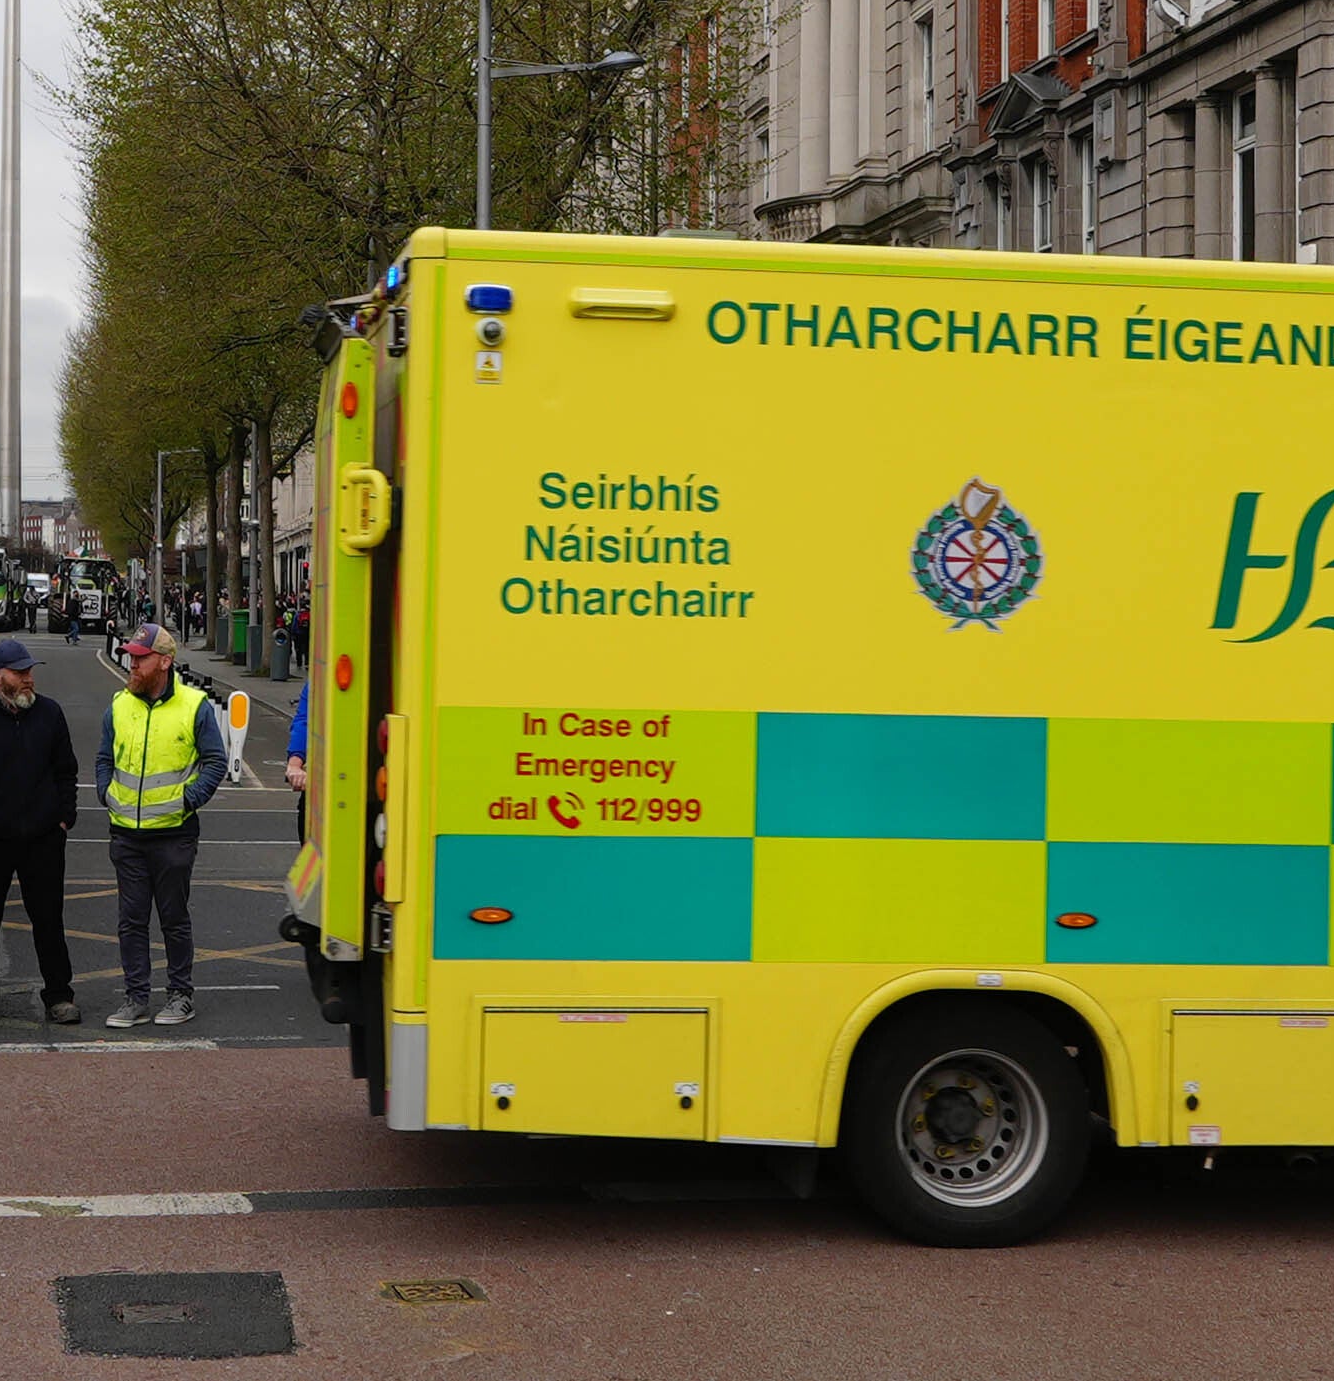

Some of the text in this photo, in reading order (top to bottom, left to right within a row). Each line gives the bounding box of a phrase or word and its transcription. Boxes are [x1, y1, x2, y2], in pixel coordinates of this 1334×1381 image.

[707, 300, 1100, 358] OTHARCHARR
[539, 472, 720, 513] Seirbhís
[524, 524, 732, 566] Náisiúnta
[500, 577, 756, 618] Otharchairr
[523, 712, 671, 738] In Case of
[516, 752, 676, 784] Emergency
[488, 797, 703, 825] dial 112/999
